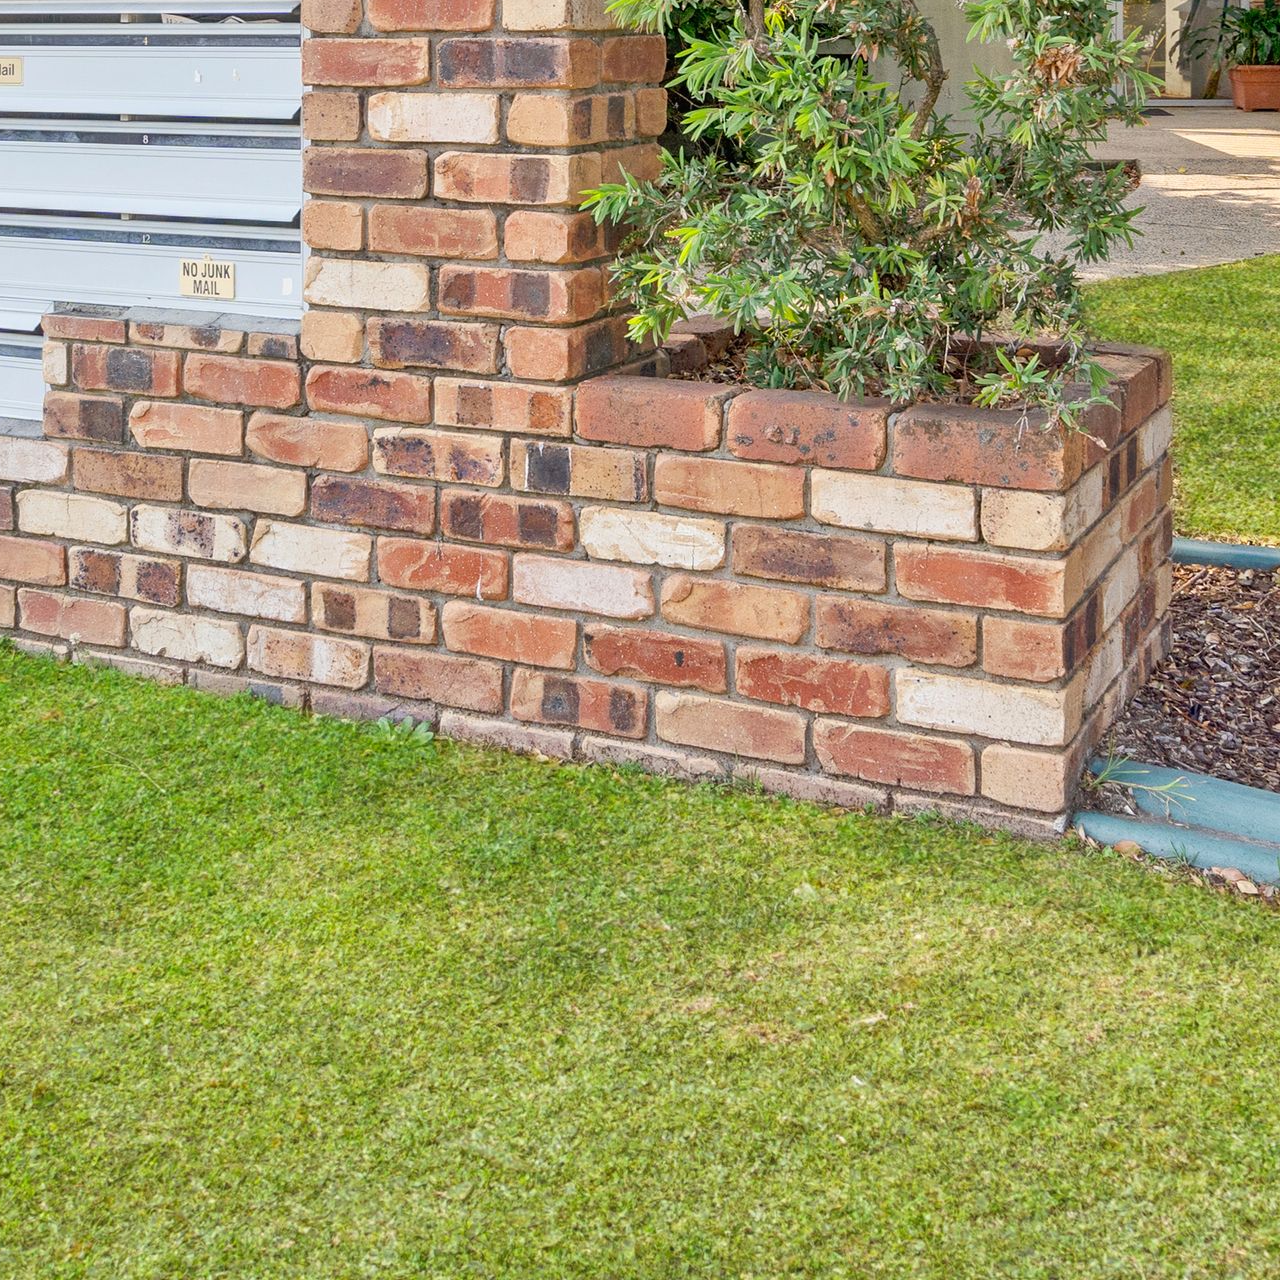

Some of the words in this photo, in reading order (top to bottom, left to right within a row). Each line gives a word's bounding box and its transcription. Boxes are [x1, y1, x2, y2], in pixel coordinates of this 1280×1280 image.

[142, 36, 149, 46] 4
[142, 135, 149, 144] 8
[142, 234, 151, 243] 12
[182, 262, 198, 277] NO
[201, 263, 231, 279] JUNK
[193, 279, 220, 295] MAIL
